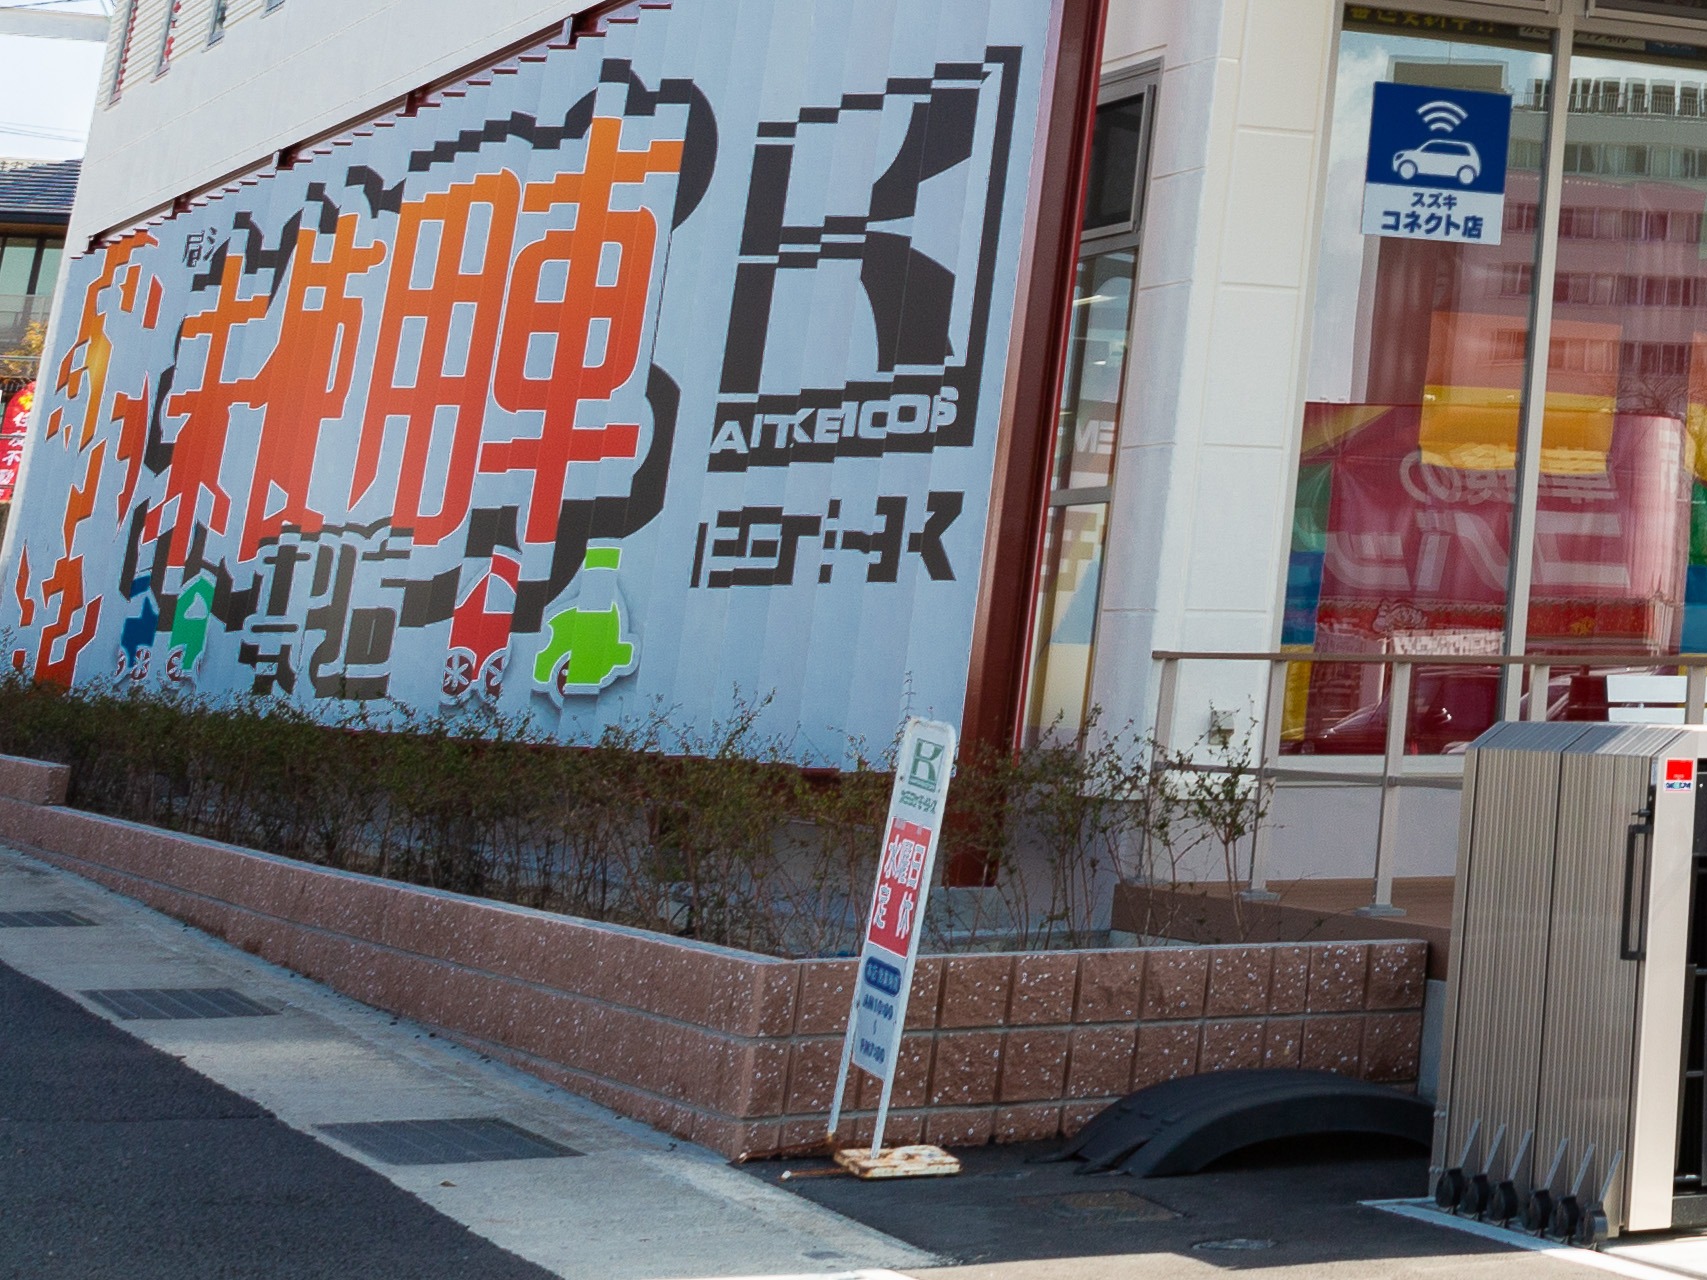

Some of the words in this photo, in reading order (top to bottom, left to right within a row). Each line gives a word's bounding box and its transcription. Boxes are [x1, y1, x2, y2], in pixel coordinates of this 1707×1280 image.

[1410, 191, 1458, 211] スズキ
[1381, 210, 1484, 239] コネクト店
[871, 881, 914, 940] 定休
